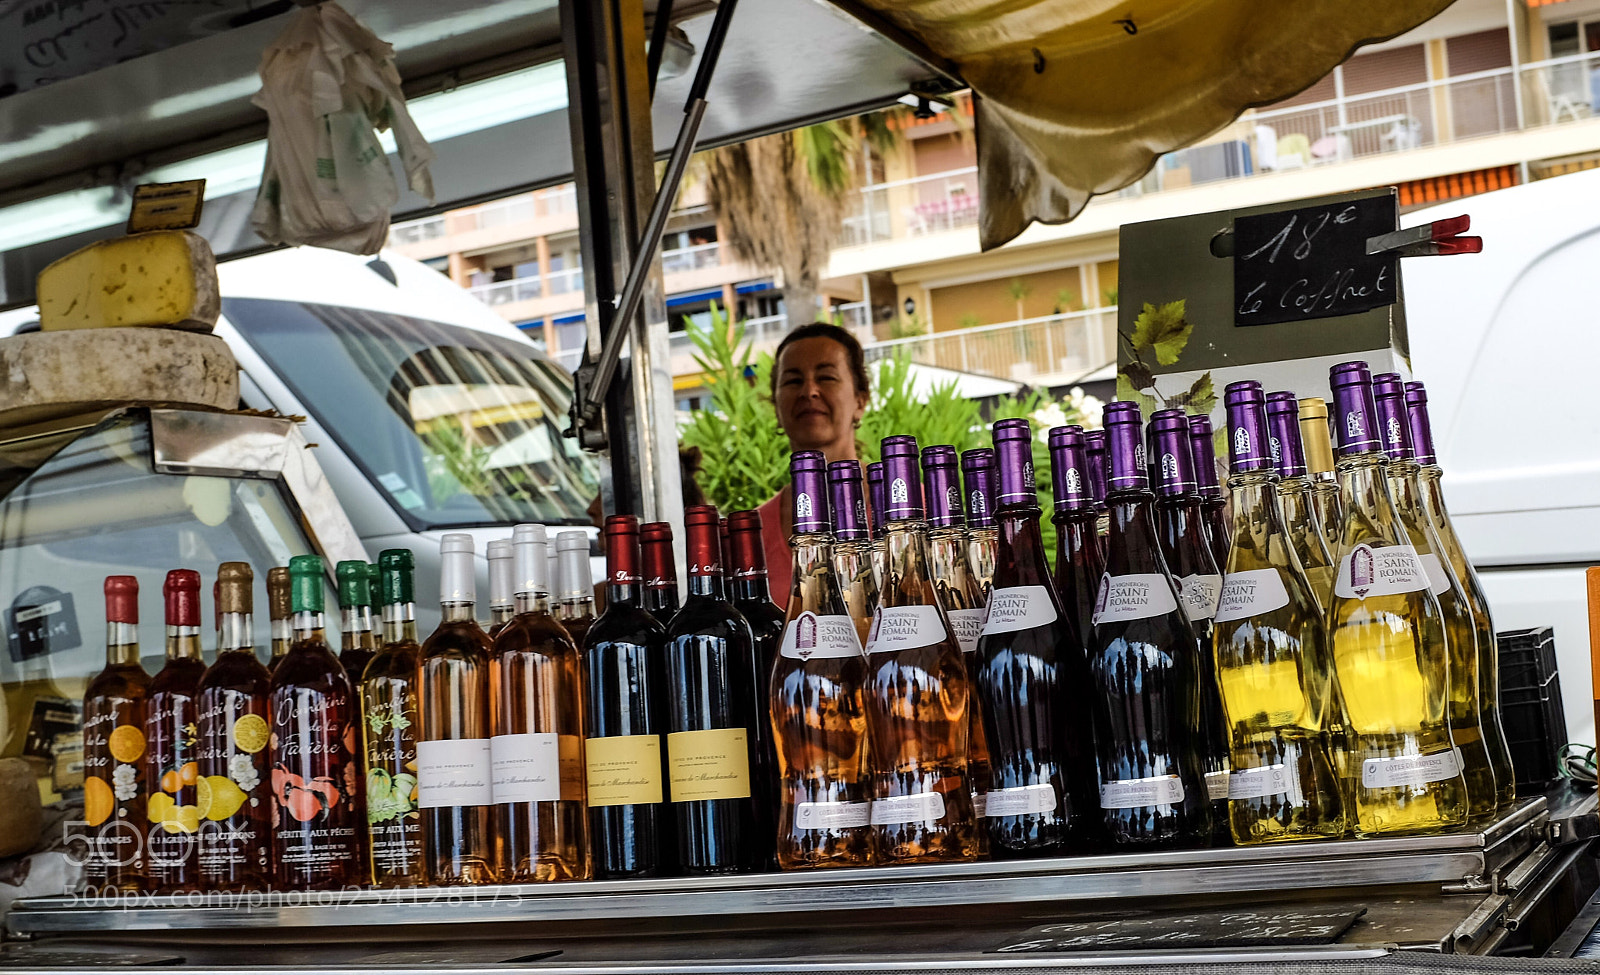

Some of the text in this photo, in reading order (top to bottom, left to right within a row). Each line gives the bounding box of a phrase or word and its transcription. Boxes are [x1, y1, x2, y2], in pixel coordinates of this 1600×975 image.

[1279, 265, 1386, 313] Coffret
[1384, 558, 1415, 569] SAINT
[1379, 568, 1418, 578] ROMAIN
[1116, 587, 1149, 597] SAINT
[1227, 586, 1256, 596] SAINT
[997, 600, 1029, 609] SAINT
[1110, 597, 1148, 607] ROMAIN
[1222, 596, 1255, 606] ROMAIN
[992, 609, 1027, 619] ROMAIN
[888, 618, 919, 627] SAINT
[951, 621, 981, 630] SAINT
[826, 626, 853, 637] SAINT
[882, 627, 918, 637] ROMAIN
[954, 629, 982, 637] OMAIN
[822, 635, 855, 644] ROMAIN
[1131, 785, 1158, 793] PROVENCE
[895, 802, 920, 810] PROVENCE
[310, 829, 328, 837] AUX
[405, 824, 420, 832] ME
